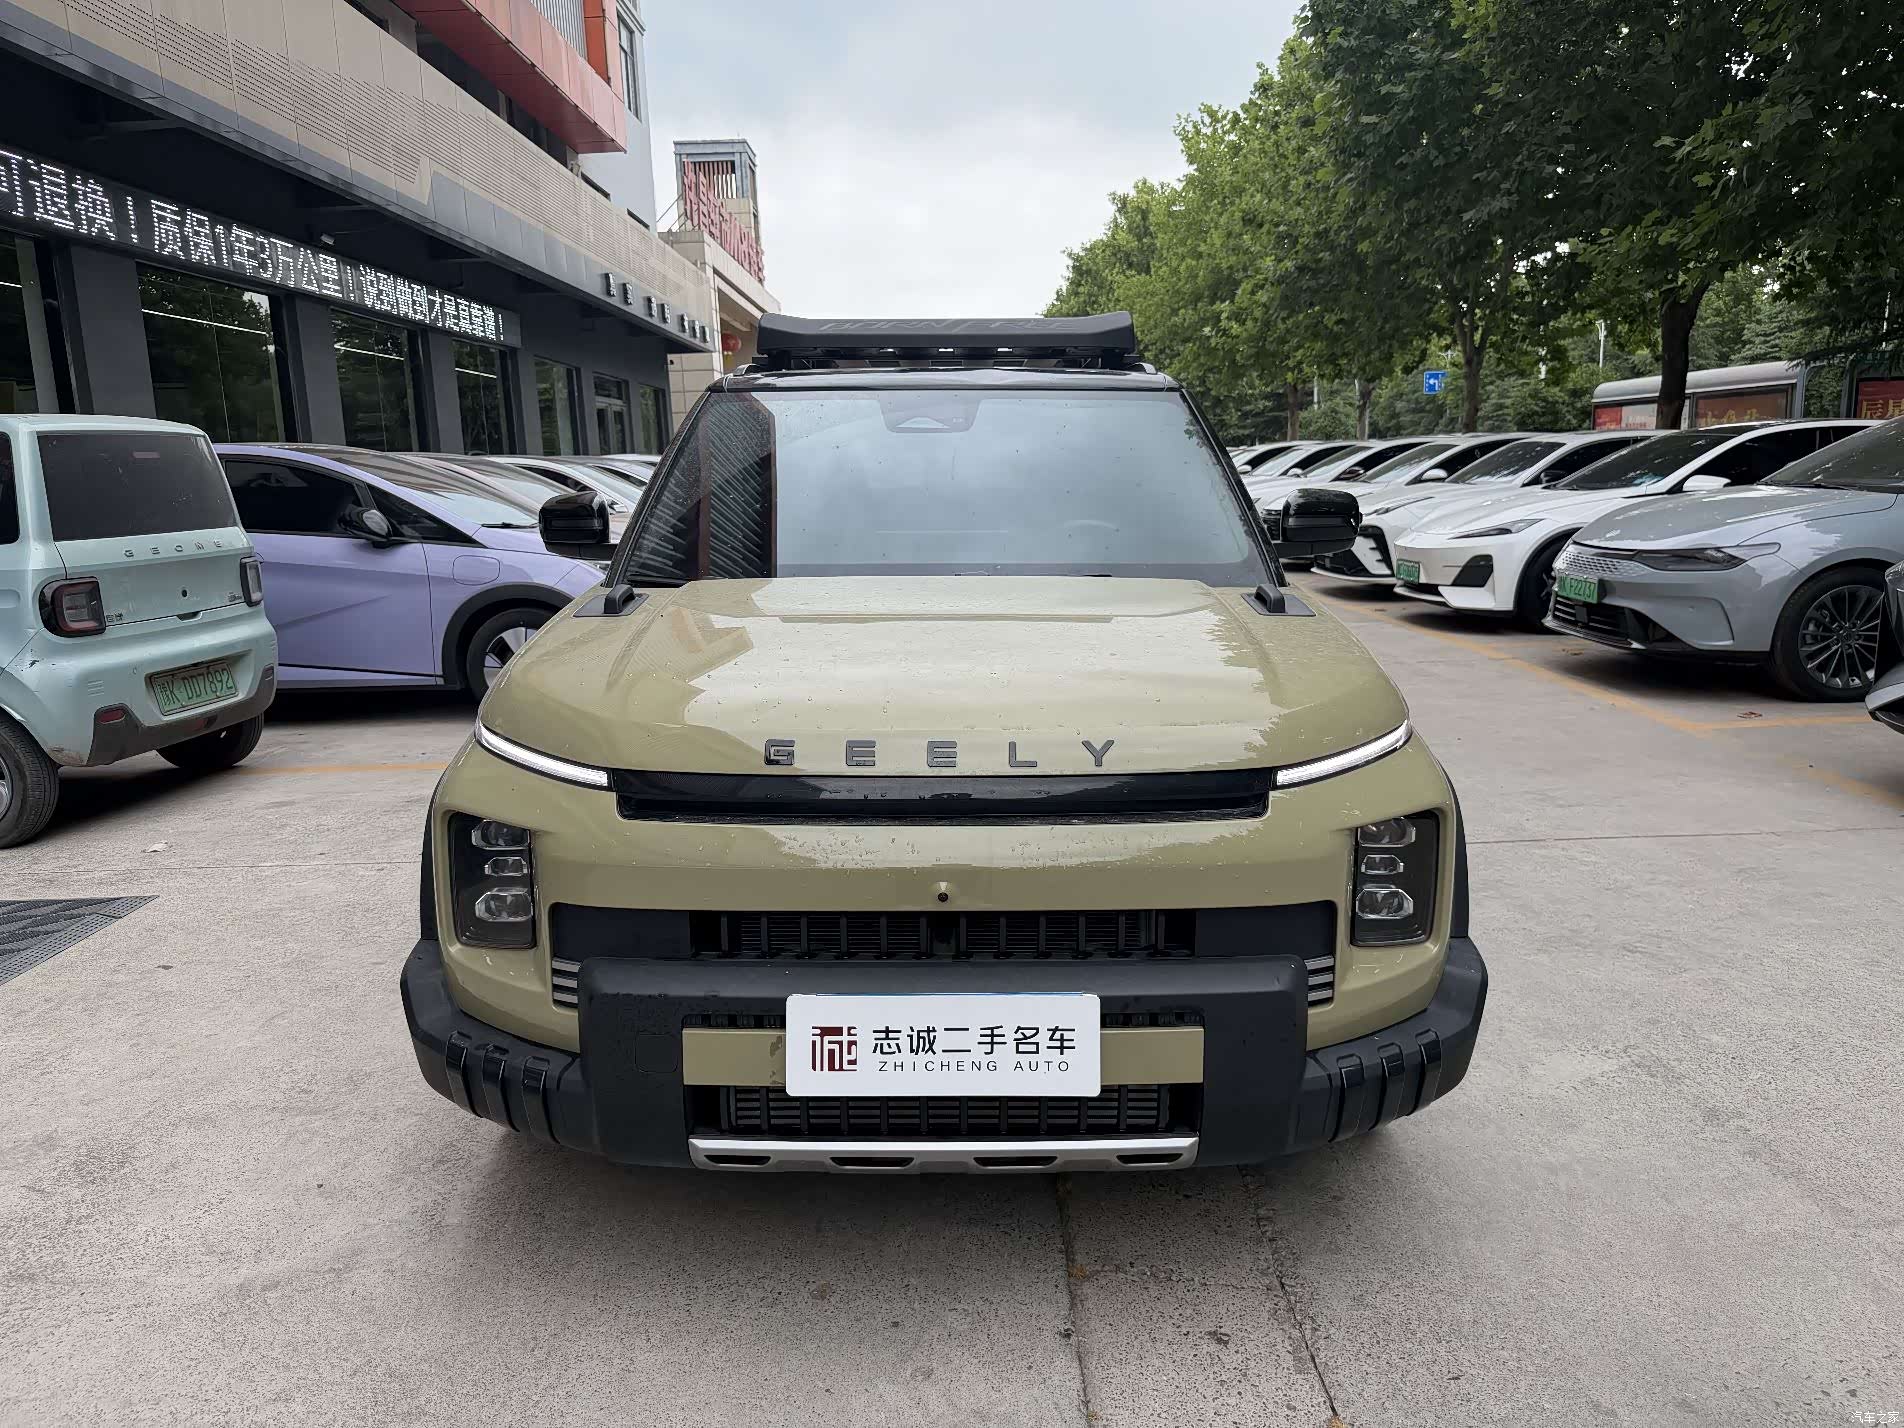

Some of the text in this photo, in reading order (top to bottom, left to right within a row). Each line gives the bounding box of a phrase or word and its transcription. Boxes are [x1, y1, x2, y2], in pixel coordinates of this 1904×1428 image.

[123, 540, 223, 558] GEOME
[764, 739, 1115, 767] GEELY
[872, 1025, 1076, 1056] 志诚二手名车
[878, 1060, 1069, 1072] ZHICHENG AUTO
